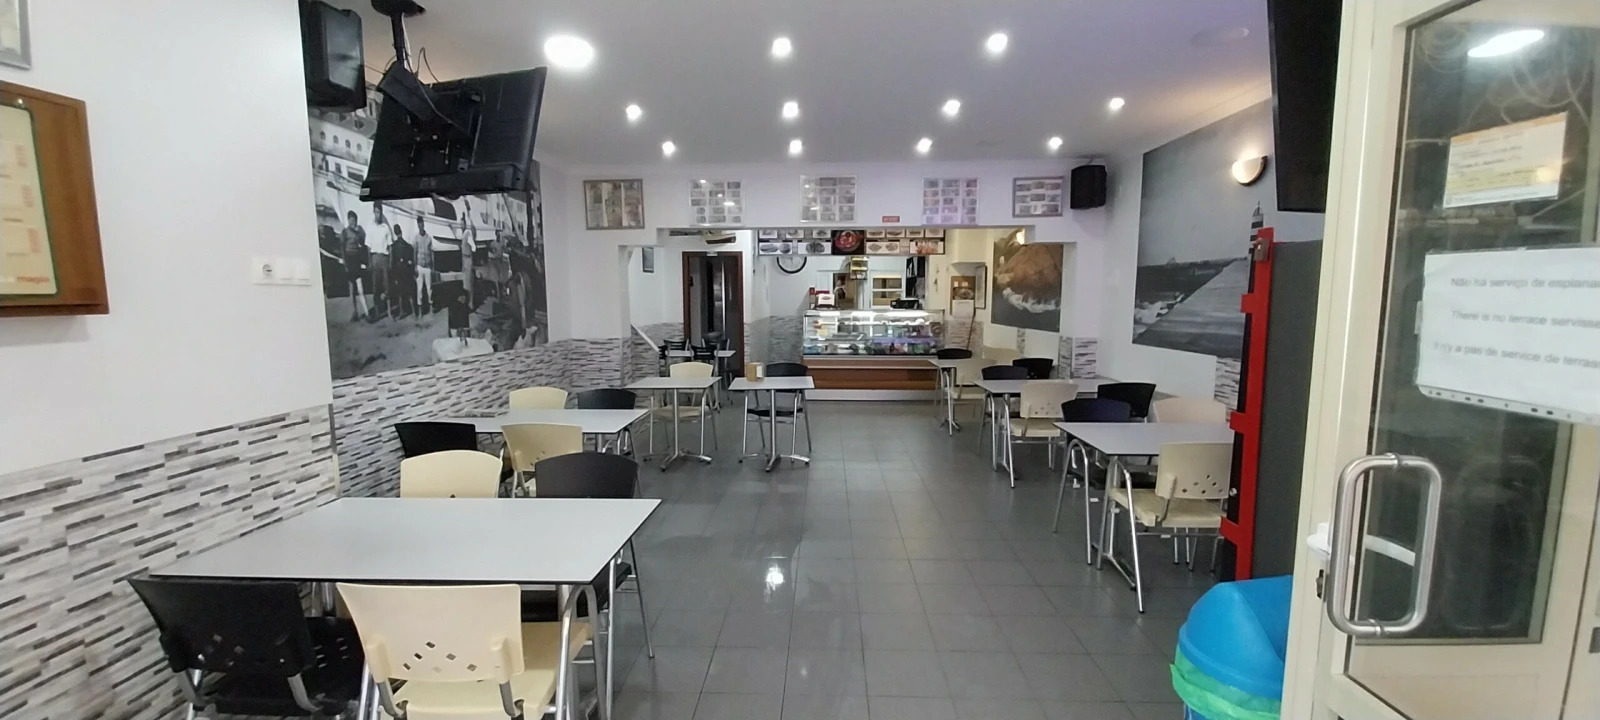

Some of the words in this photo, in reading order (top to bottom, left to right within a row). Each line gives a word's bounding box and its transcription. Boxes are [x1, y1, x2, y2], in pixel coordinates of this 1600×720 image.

[1531, 277, 1545, 288] de
[1508, 314, 1547, 326] terrace
[1500, 349, 1541, 362] service
[1543, 353, 1560, 364] de
